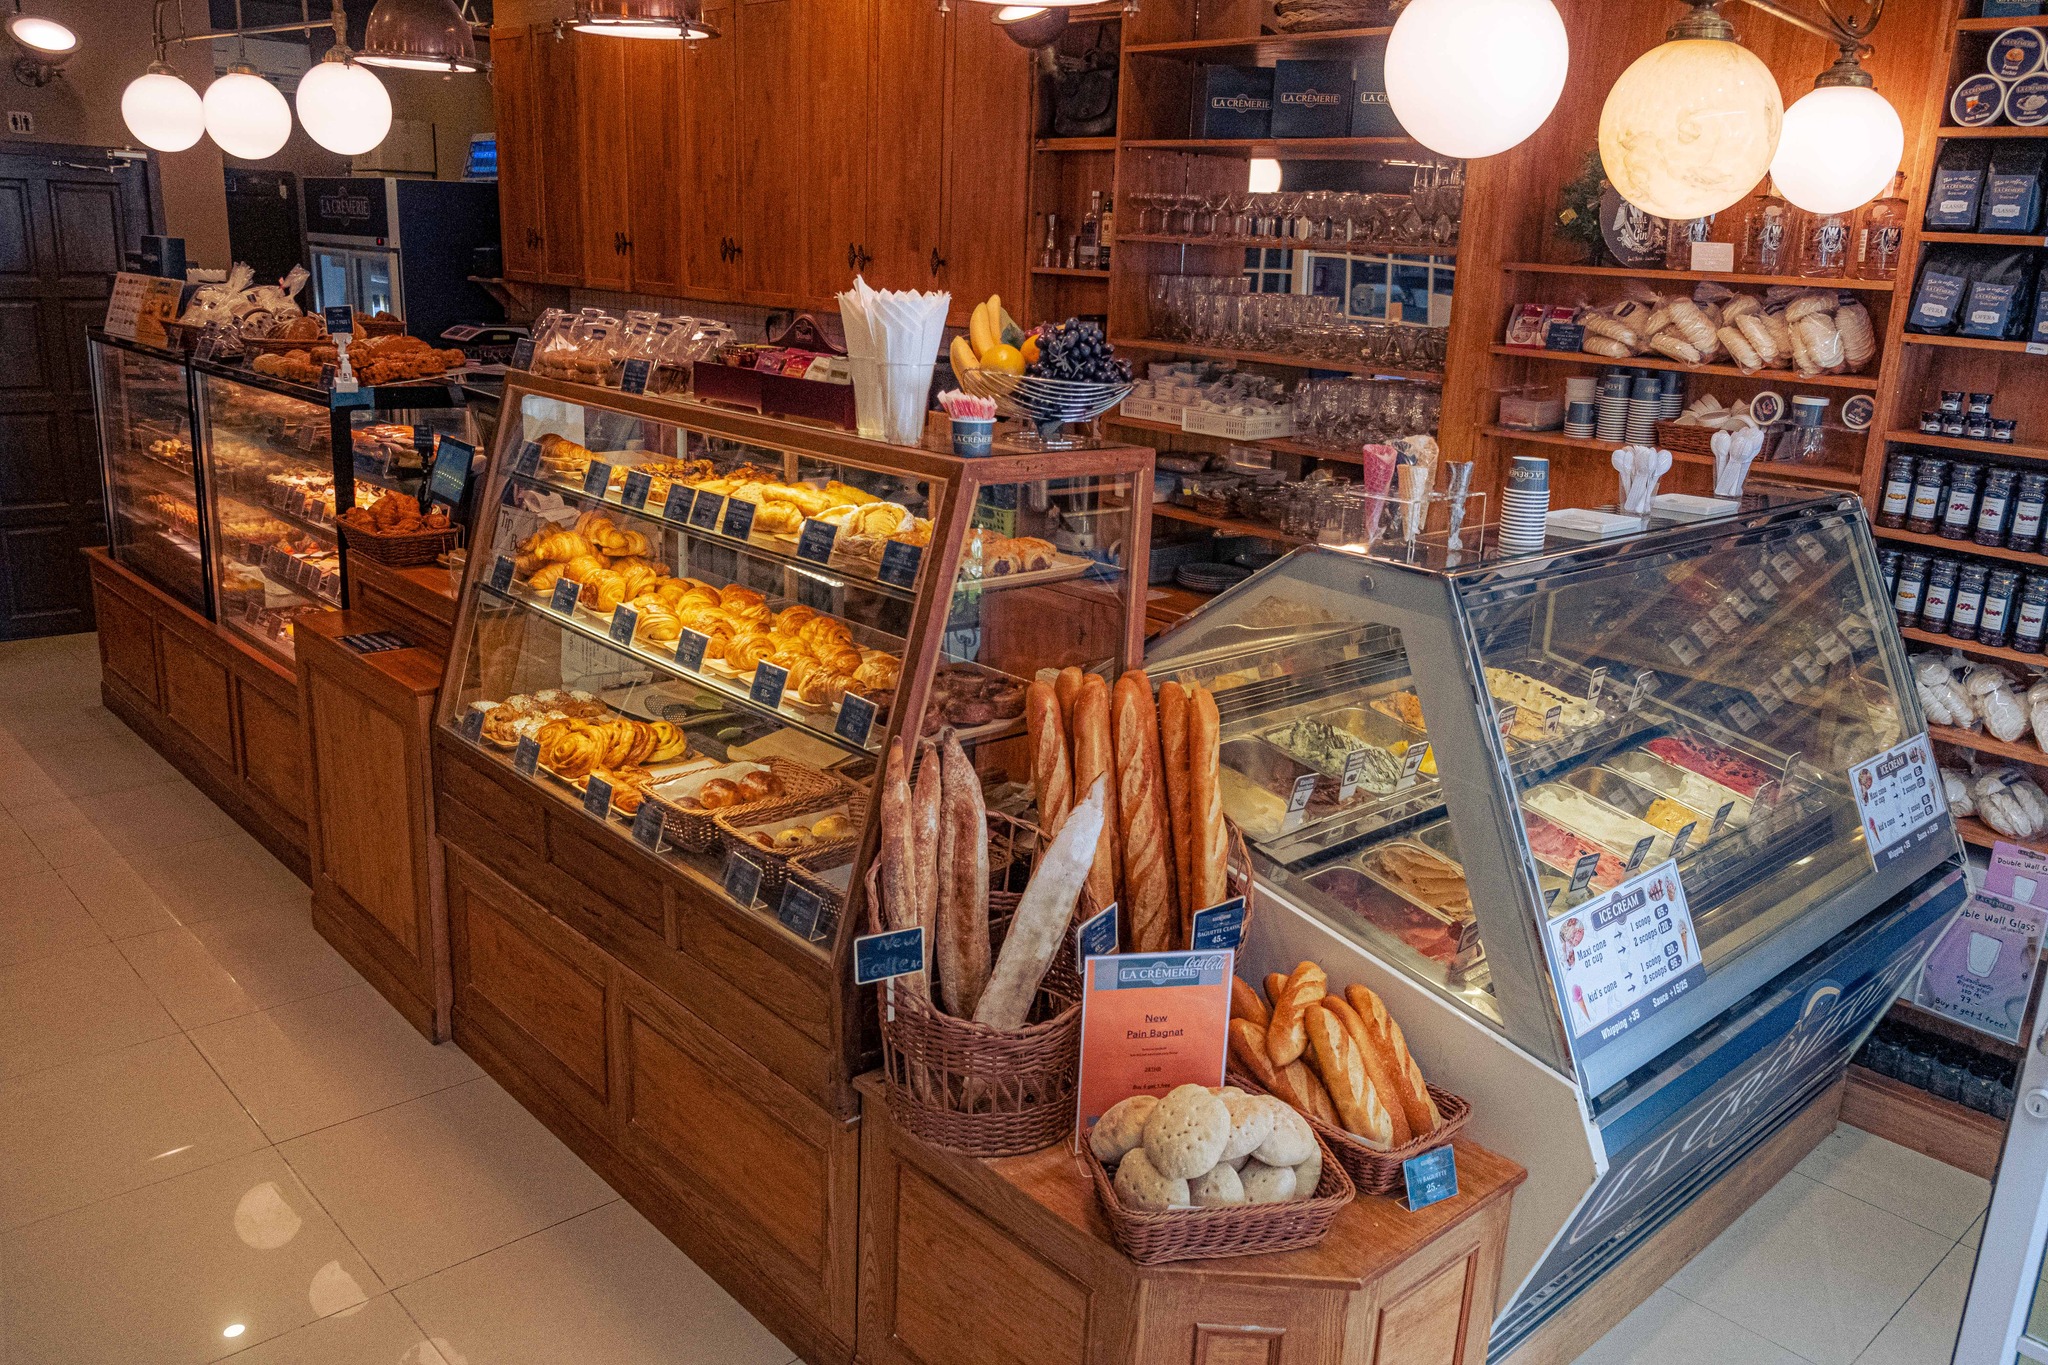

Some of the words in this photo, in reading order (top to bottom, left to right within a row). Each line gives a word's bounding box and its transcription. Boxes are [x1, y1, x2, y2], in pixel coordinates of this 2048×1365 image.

[1283, 94, 1294, 102] LA
[1296, 92, 1339, 103] CRÊMERIE
[1363, 94, 1375, 102] LA
[1634, 230, 1647, 242] Gin
[1924, 306, 1944, 314] OPERA
[1975, 313, 1996, 321] OPERA
[502, 510, 513, 536] Tip
[1880, 762, 1889, 776] ICE
[1888, 756, 1905, 772] CREAM
[1998, 857, 2022, 868] Double
[2024, 862, 2040, 870] Wall
[1598, 905, 1613, 925] ICE
[1612, 895, 1640, 920] CREAM
[1635, 915, 1652, 930] scoop
[1961, 909, 1980, 920] ble
[1984, 913, 2006, 925] Wall
[2010, 918, 2036, 932] Glass
[1198, 928, 1222, 938] BAGUETTE
[1212, 936, 1226, 944] 45.-
[1634, 937, 1638, 946] 2
[1639, 928, 1658, 944] scoops
[878, 932, 921, 950] New
[1577, 944, 1592, 961] Maxi
[1592, 940, 1607, 954] cone
[1584, 958, 1592, 968] or
[1592, 954, 1604, 968] cup
[1645, 954, 1662, 970] scoop
[1122, 970, 1136, 980] LA
[1140, 967, 1196, 980] CRÊMERIE
[1643, 975, 1648, 984] 2
[1648, 966, 1668, 982] scoops
[1588, 987, 1603, 1004] kid's
[1603, 980, 1618, 996] cone
[1652, 992, 1669, 1008] Sauce
[1668, 978, 1689, 998] +15/25
[1145, 1014, 1168, 1023] New
[1936, 996, 1950, 1009] Buy
[1960, 1009, 1974, 1018] get
[1976, 1012, 1982, 1020] 1
[1985, 1016, 2008, 1029] free!
[1601, 1016, 1628, 1040] Whipping
[1628, 1008, 1640, 1024] +35
[1126, 1030, 1146, 1039] Pain
[1150, 1028, 1184, 1038] Bagnat
[1426, 1182, 1440, 1193] 25.-
[1589, 1133, 1678, 1229] LA
